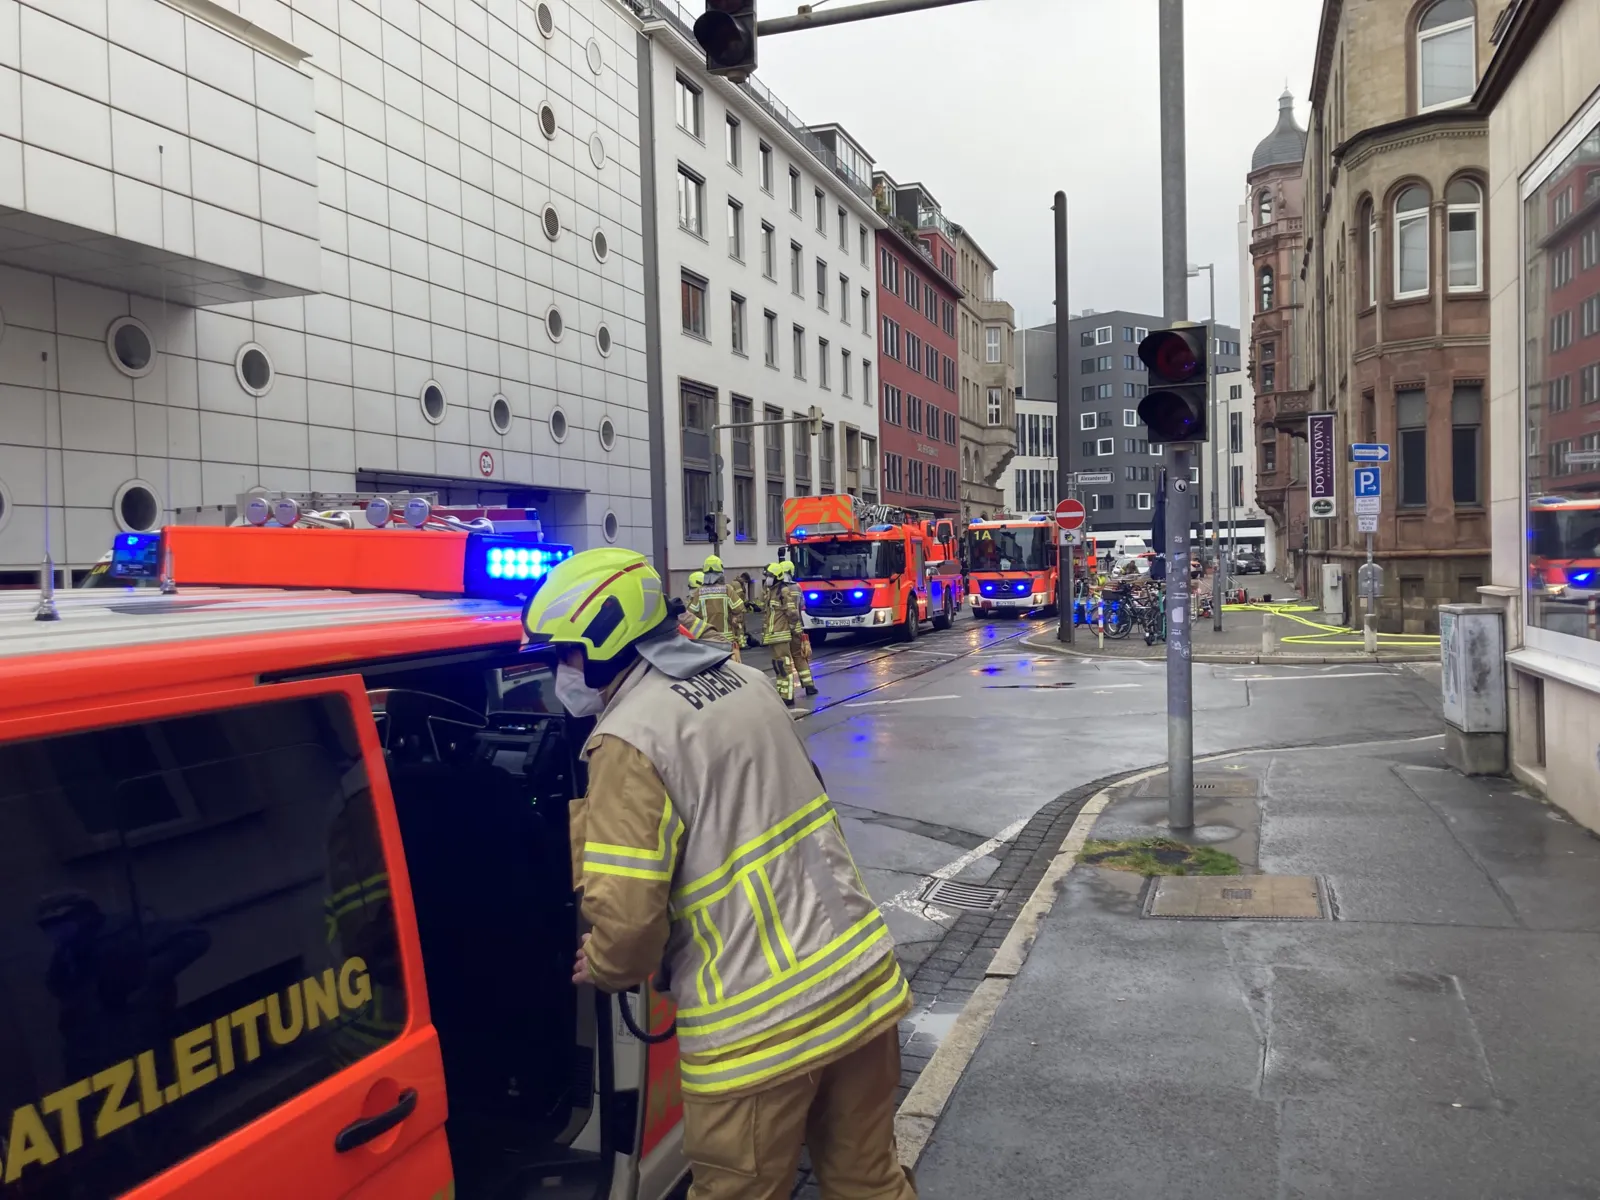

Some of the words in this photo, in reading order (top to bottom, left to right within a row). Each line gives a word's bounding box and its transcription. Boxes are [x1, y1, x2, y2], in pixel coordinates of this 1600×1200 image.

[1314, 420, 1325, 494] DOWNTOWN
[1360, 471, 1375, 494] P
[974, 530, 992, 541] 1A
[669, 664, 748, 711] B-DIENST
[0, 956, 373, 1184] ATZLEITUNG
